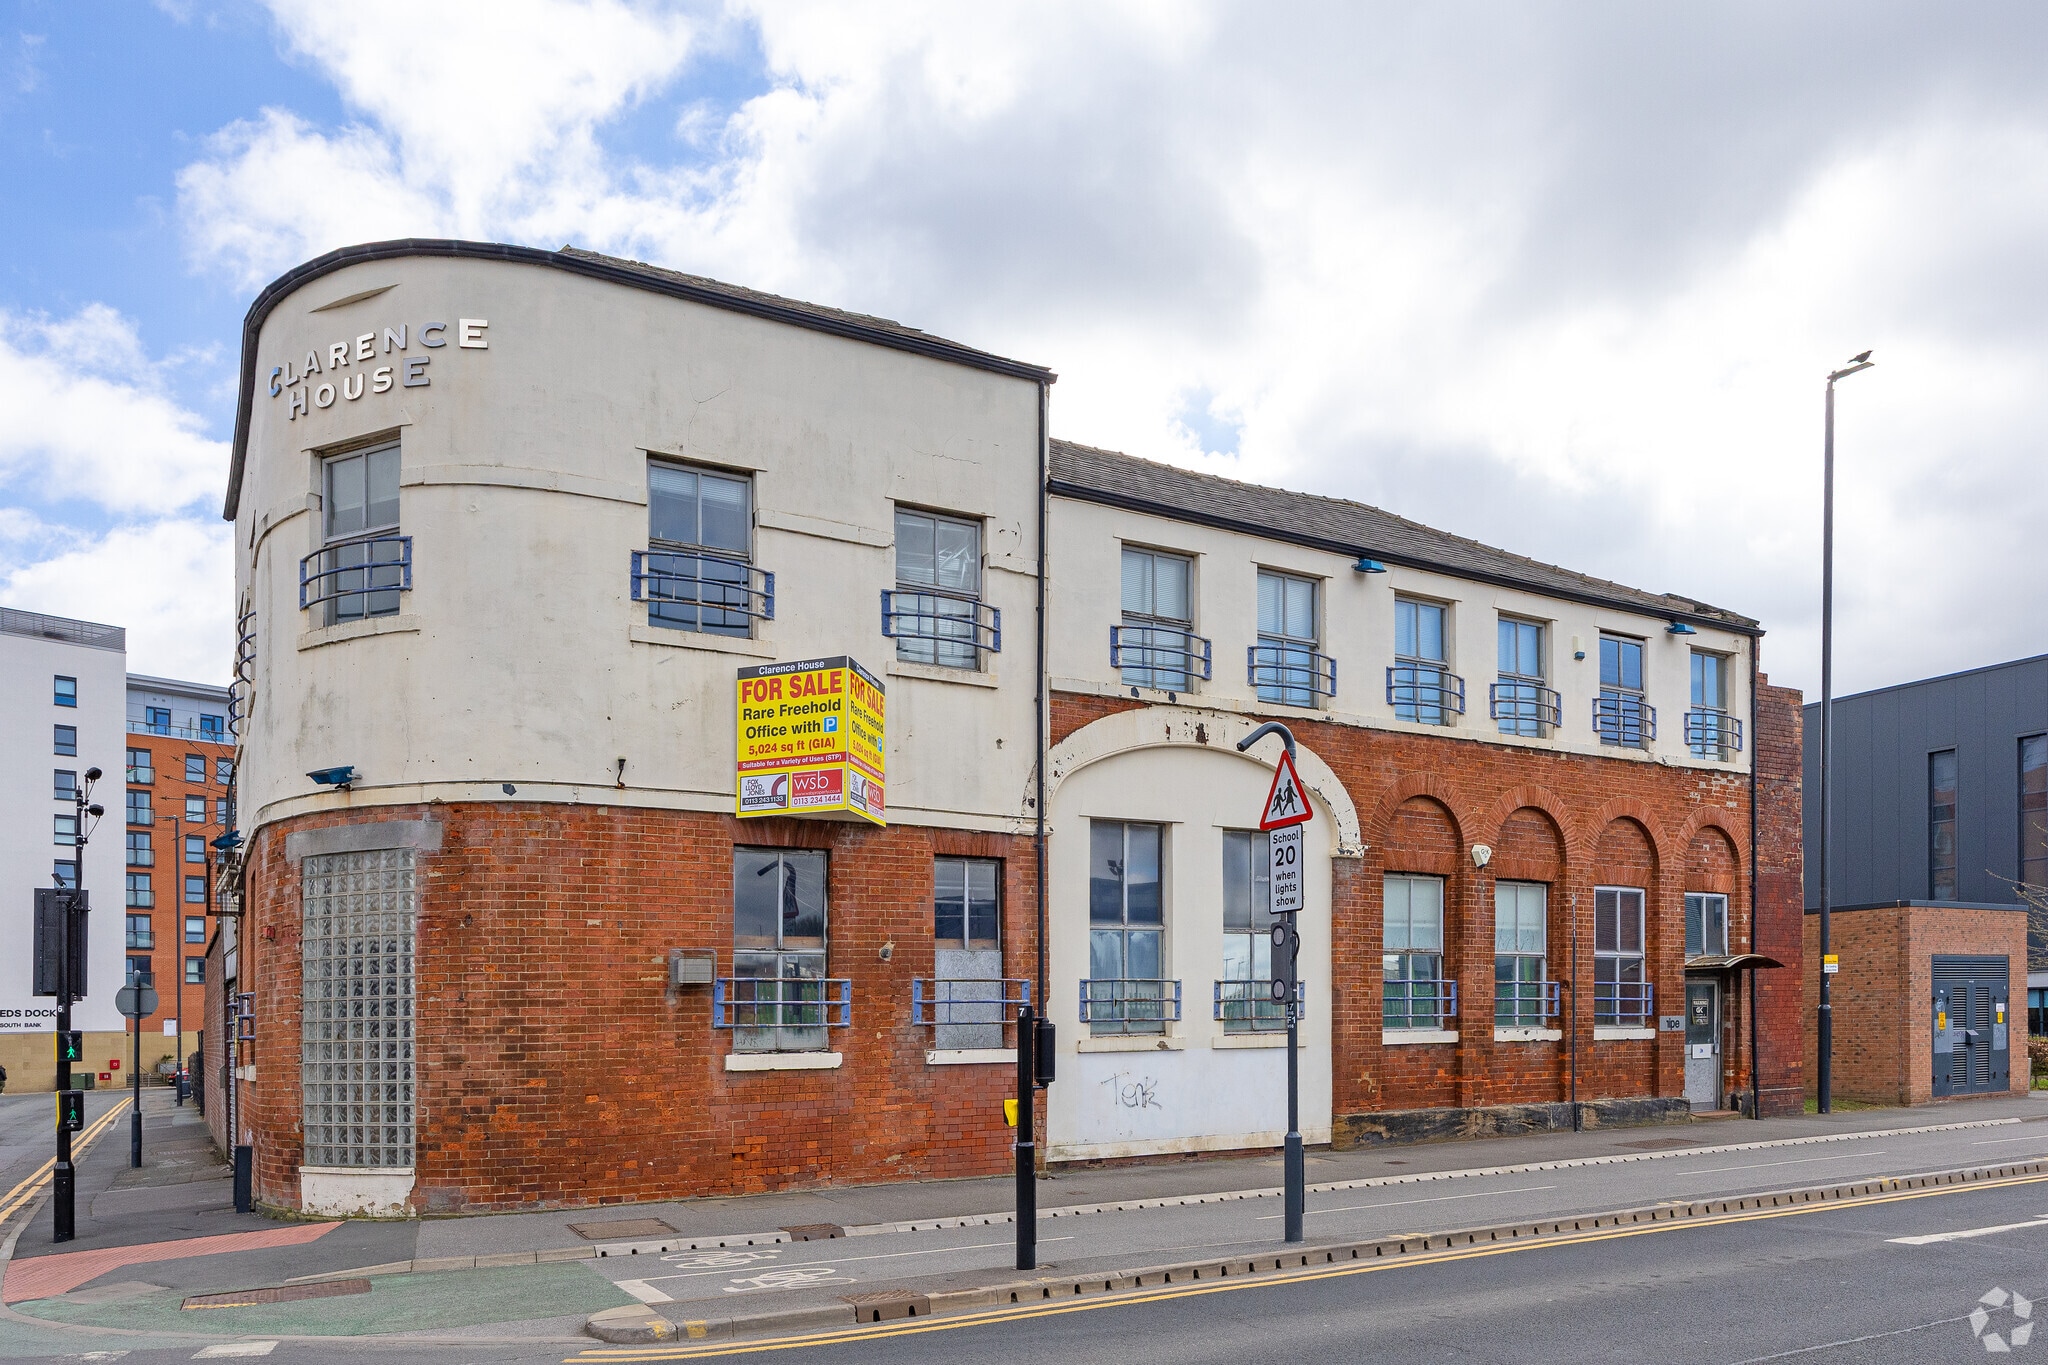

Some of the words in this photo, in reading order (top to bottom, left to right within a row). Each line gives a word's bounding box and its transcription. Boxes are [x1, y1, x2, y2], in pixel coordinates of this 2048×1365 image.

[268, 318, 488, 398] CLARENCE
[288, 355, 431, 421] HOUSE
[758, 663, 796, 675] Clarence
[797, 661, 825, 671] House
[741, 677, 783, 704] FOR
[789, 670, 843, 699] SALE
[850, 671, 865, 704] FOR
[866, 685, 884, 718] SALE
[743, 707, 775, 721] Rare
[779, 698, 841, 717] Freehold
[850, 700, 863, 719] Rare
[863, 709, 884, 734] Freehold
[745, 724, 787, 739] Office
[791, 720, 821, 734] with
[851, 720, 867, 741] Office
[748, 743, 778, 757] 5,024
[780, 743, 794, 754] sq
[796, 740, 806, 751] ft
[808, 737, 836, 751] (GIA)
[742, 761, 766, 769] Suitable
[781, 758, 801, 766] Variety
[809, 755, 825, 763] Uses
[825, 753, 842, 762] (STP)
[793, 770, 829, 790] wsb
[744, 797, 759, 805] 0113
[793, 797, 809, 805] 0113
[810, 796, 823, 804] 234
[1272, 829, 1299, 845] School
[1275, 845, 1296, 867] 20
[1275, 870, 1296, 882] when
[1275, 882, 1297, 895] lights
[1275, 895, 1296, 906] show
[0, 1009, 22, 1018] EDS
[24, 1009, 57, 1018] DOCK
[1018, 1007, 1025, 1017] 7
